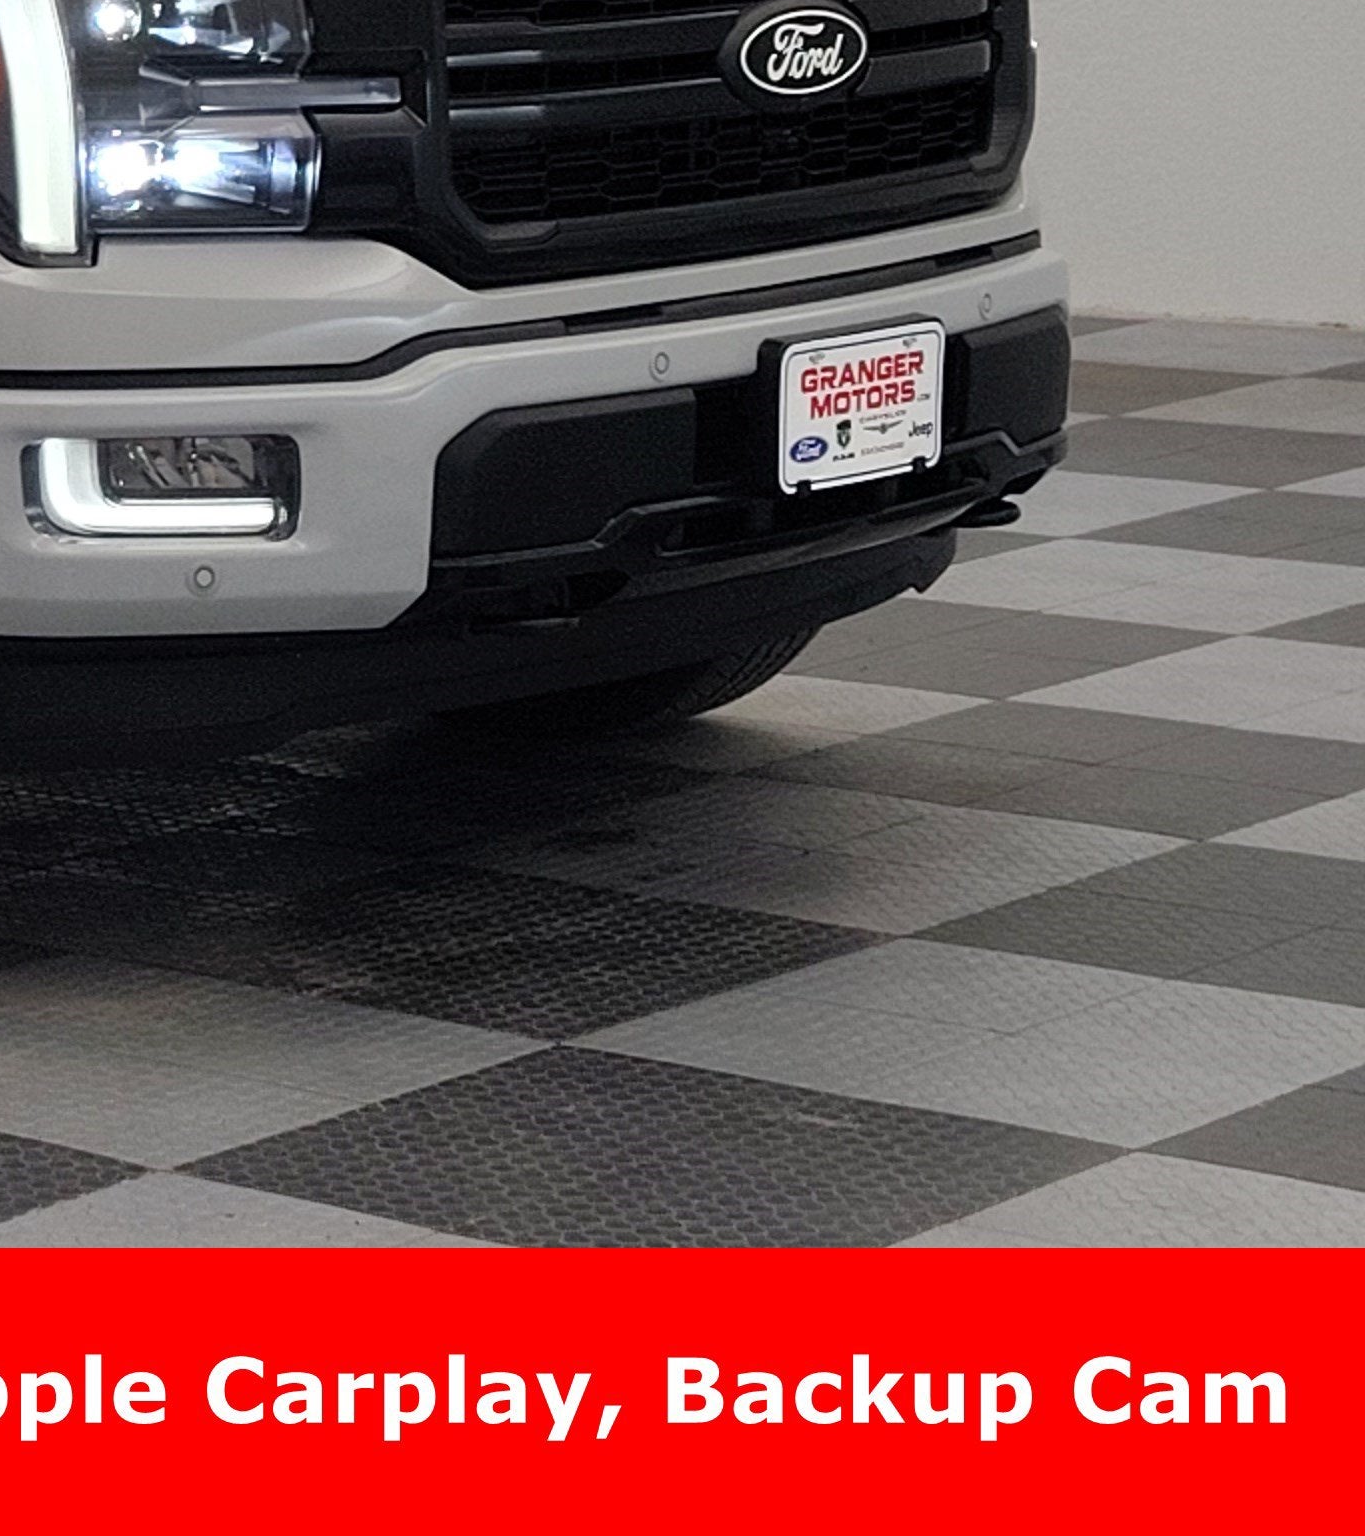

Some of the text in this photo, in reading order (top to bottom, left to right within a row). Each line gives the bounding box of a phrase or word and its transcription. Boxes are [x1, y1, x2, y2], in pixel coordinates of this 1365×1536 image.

[767, 22, 845, 81] Ford
[801, 351, 924, 394] GRANGER
[810, 379, 917, 420] MOTORS
[908, 421, 934, 438] Jeep
